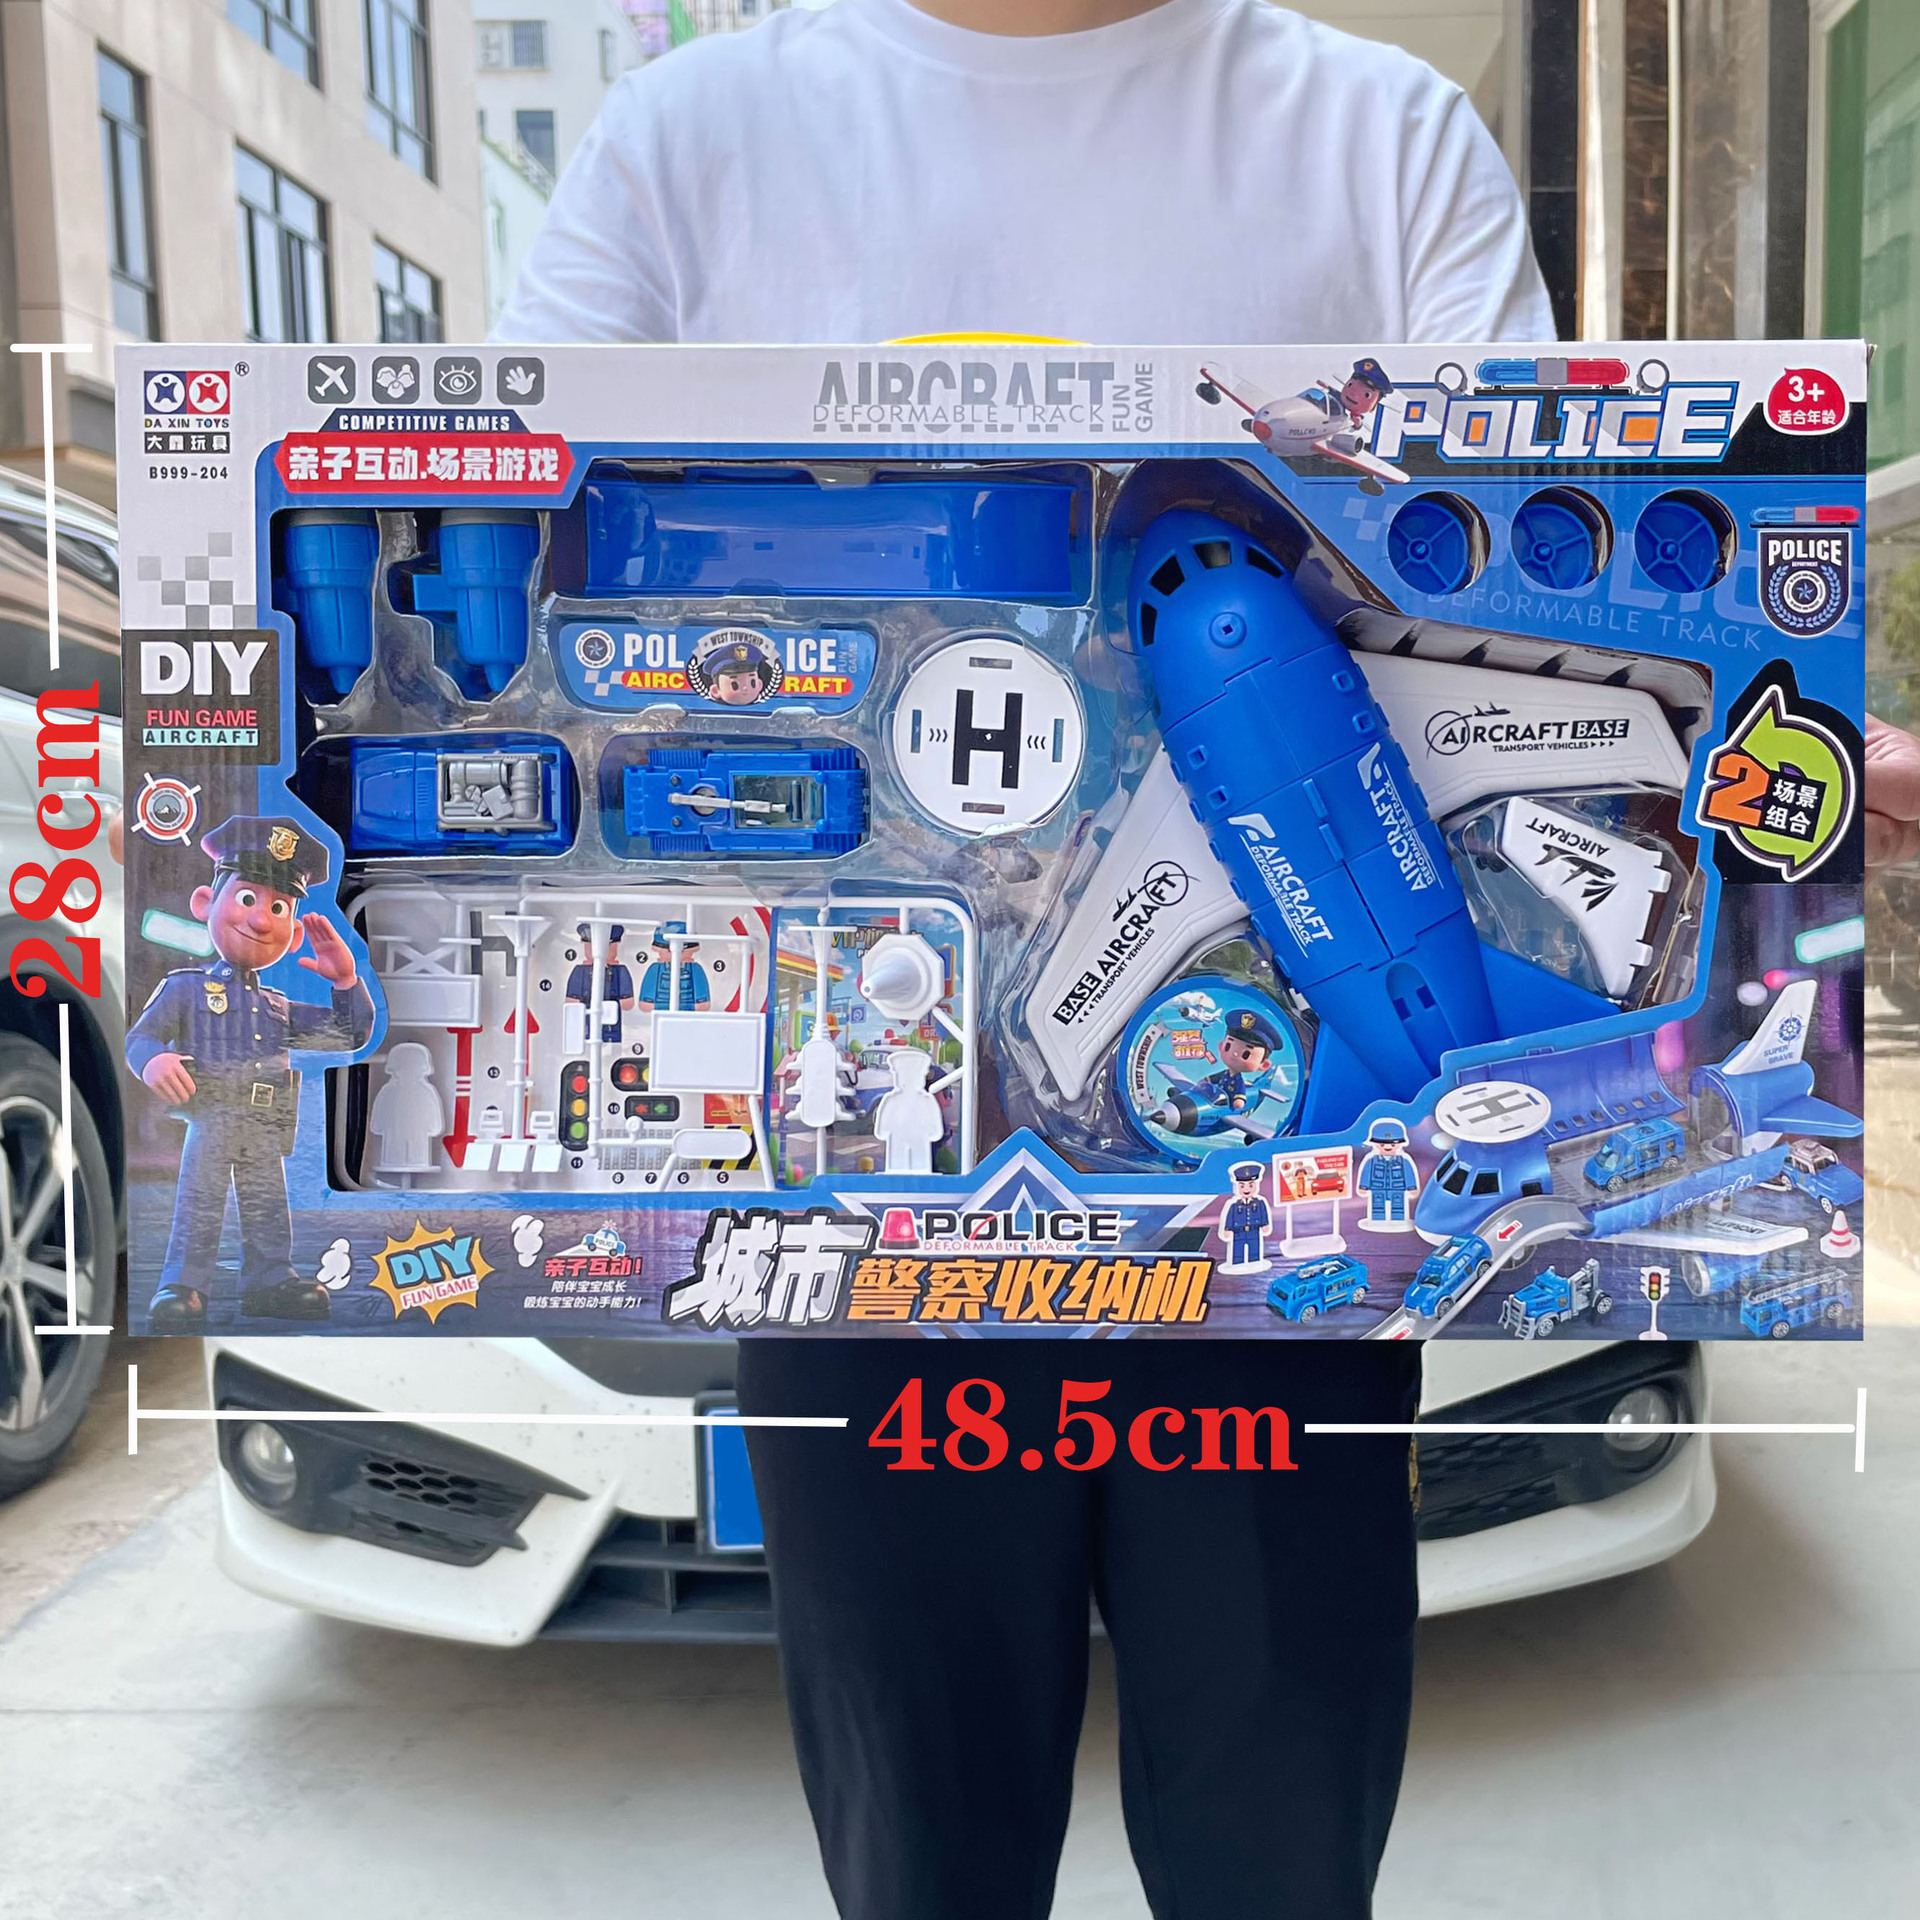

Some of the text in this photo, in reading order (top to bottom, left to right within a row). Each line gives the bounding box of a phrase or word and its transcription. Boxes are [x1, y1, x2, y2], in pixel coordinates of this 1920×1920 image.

[813, 360, 1115, 432] AIRCRAFT
[1135, 362, 1154, 433] GAME
[1787, 375, 1825, 402] 3+
[144, 418, 229, 428] DA XIN TOYS
[338, 415, 511, 431] COMPETITIVE GAMES
[812, 404, 1104, 424] DEFORMABLE TRACK
[1112, 384, 1131, 433] FUN
[1373, 384, 1738, 460] POLICE
[1777, 409, 1836, 425] 适合年龄
[149, 466, 229, 479] B999-204
[1767, 539, 1843, 567] POLICE
[709, 631, 764, 647] WEST TOWNSHIP
[1657, 614, 1763, 652] TRACK
[139, 640, 269, 697] DIY
[623, 633, 685, 669] POL
[786, 637, 837, 673] ICE
[625, 671, 847, 694] AIRC RAFT
[146, 709, 258, 726] FUN GAME
[1441, 720, 1627, 746] AIRCRAFT BASE
[144, 729, 257, 744] AIRCRAFT
[952, 688, 1023, 790] H
[1492, 741, 1589, 753] TRANSPORT VEHICLES
[1707, 752, 1770, 827] 2
[1772, 778, 1819, 809] 场景
[1764, 804, 1812, 836] 组合
[1369, 787, 1428, 891] AIRCRAFT
[1525, 817, 1611, 858] AIRCRAFT
[1258, 844, 1334, 941] AIRCRAFT
[1290, 910, 1315, 945] TRACK
[1057, 871, 1177, 1020] BASE AIRCRAFT
[1091, 927, 1155, 1004] TRANSPORT VEHICLES
[1763, 1045, 1789, 1057] SUPER
[1768, 1052, 1793, 1064] BRAVE
[924, 1212, 1119, 1241] POLICE
[390, 1236, 473, 1286] DIY
[924, 1241, 1075, 1251] DEFORMABLE TRACK
[668, 1215, 1215, 1326] 城市 警察收纳机
[402, 1276, 478, 1307] FUN GAME
[551, 1280, 628, 1293] 陪伴宝宝成长
